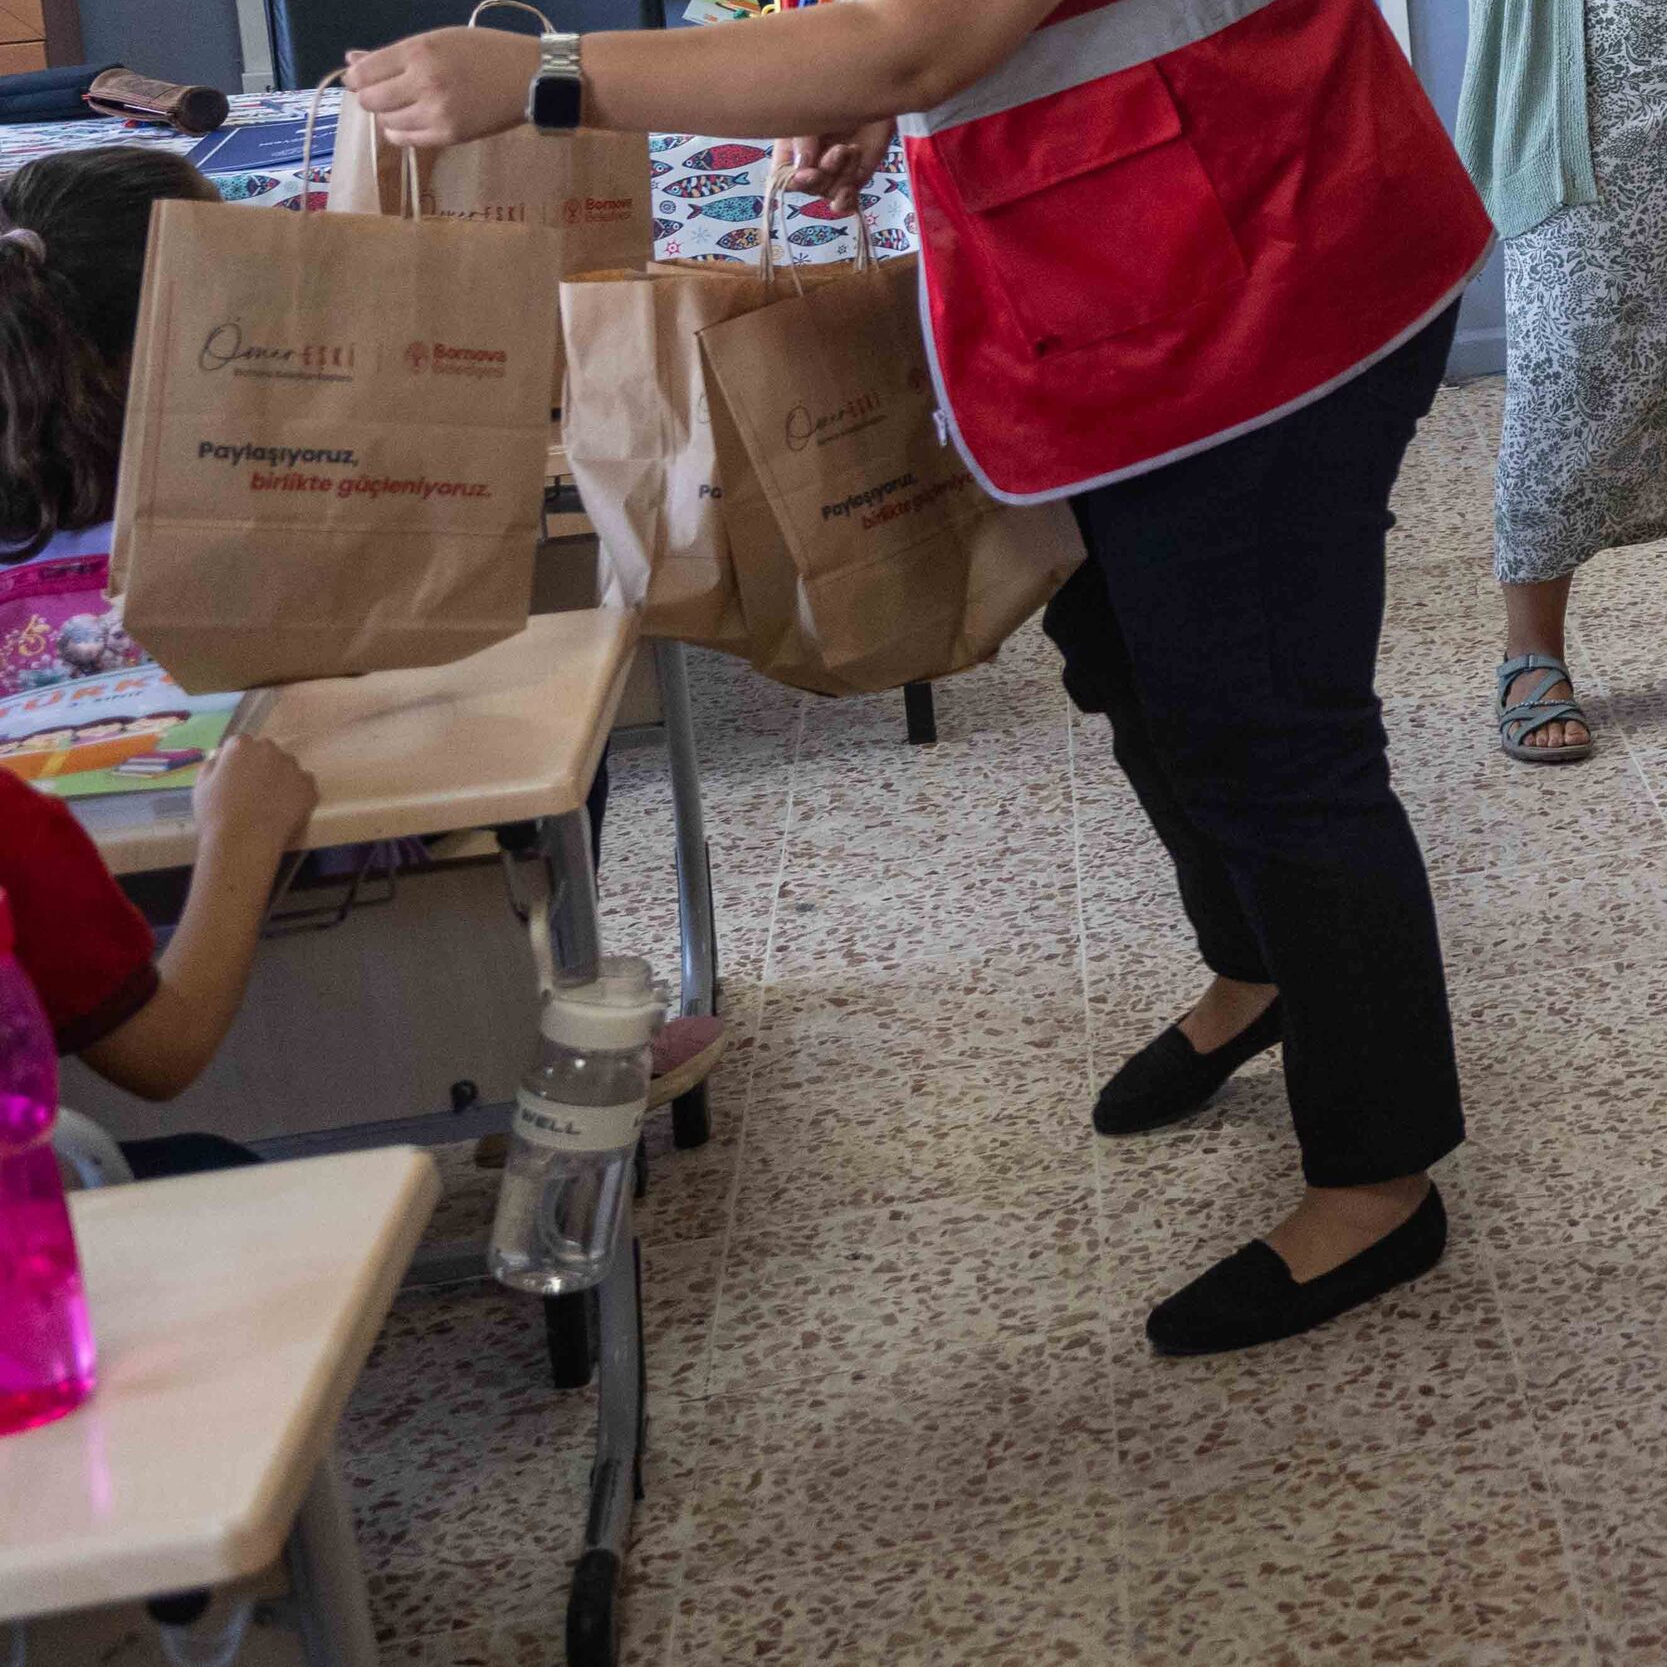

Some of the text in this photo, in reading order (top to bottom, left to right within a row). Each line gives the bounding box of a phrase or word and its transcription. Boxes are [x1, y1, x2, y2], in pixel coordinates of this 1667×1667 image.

[586, 197, 633, 211] Bornova
[432, 343, 507, 363] Bornova
[198, 441, 359, 467] Paylaşıyoruz,
[250, 471, 492, 499] birlikte güçleniyoruz.
